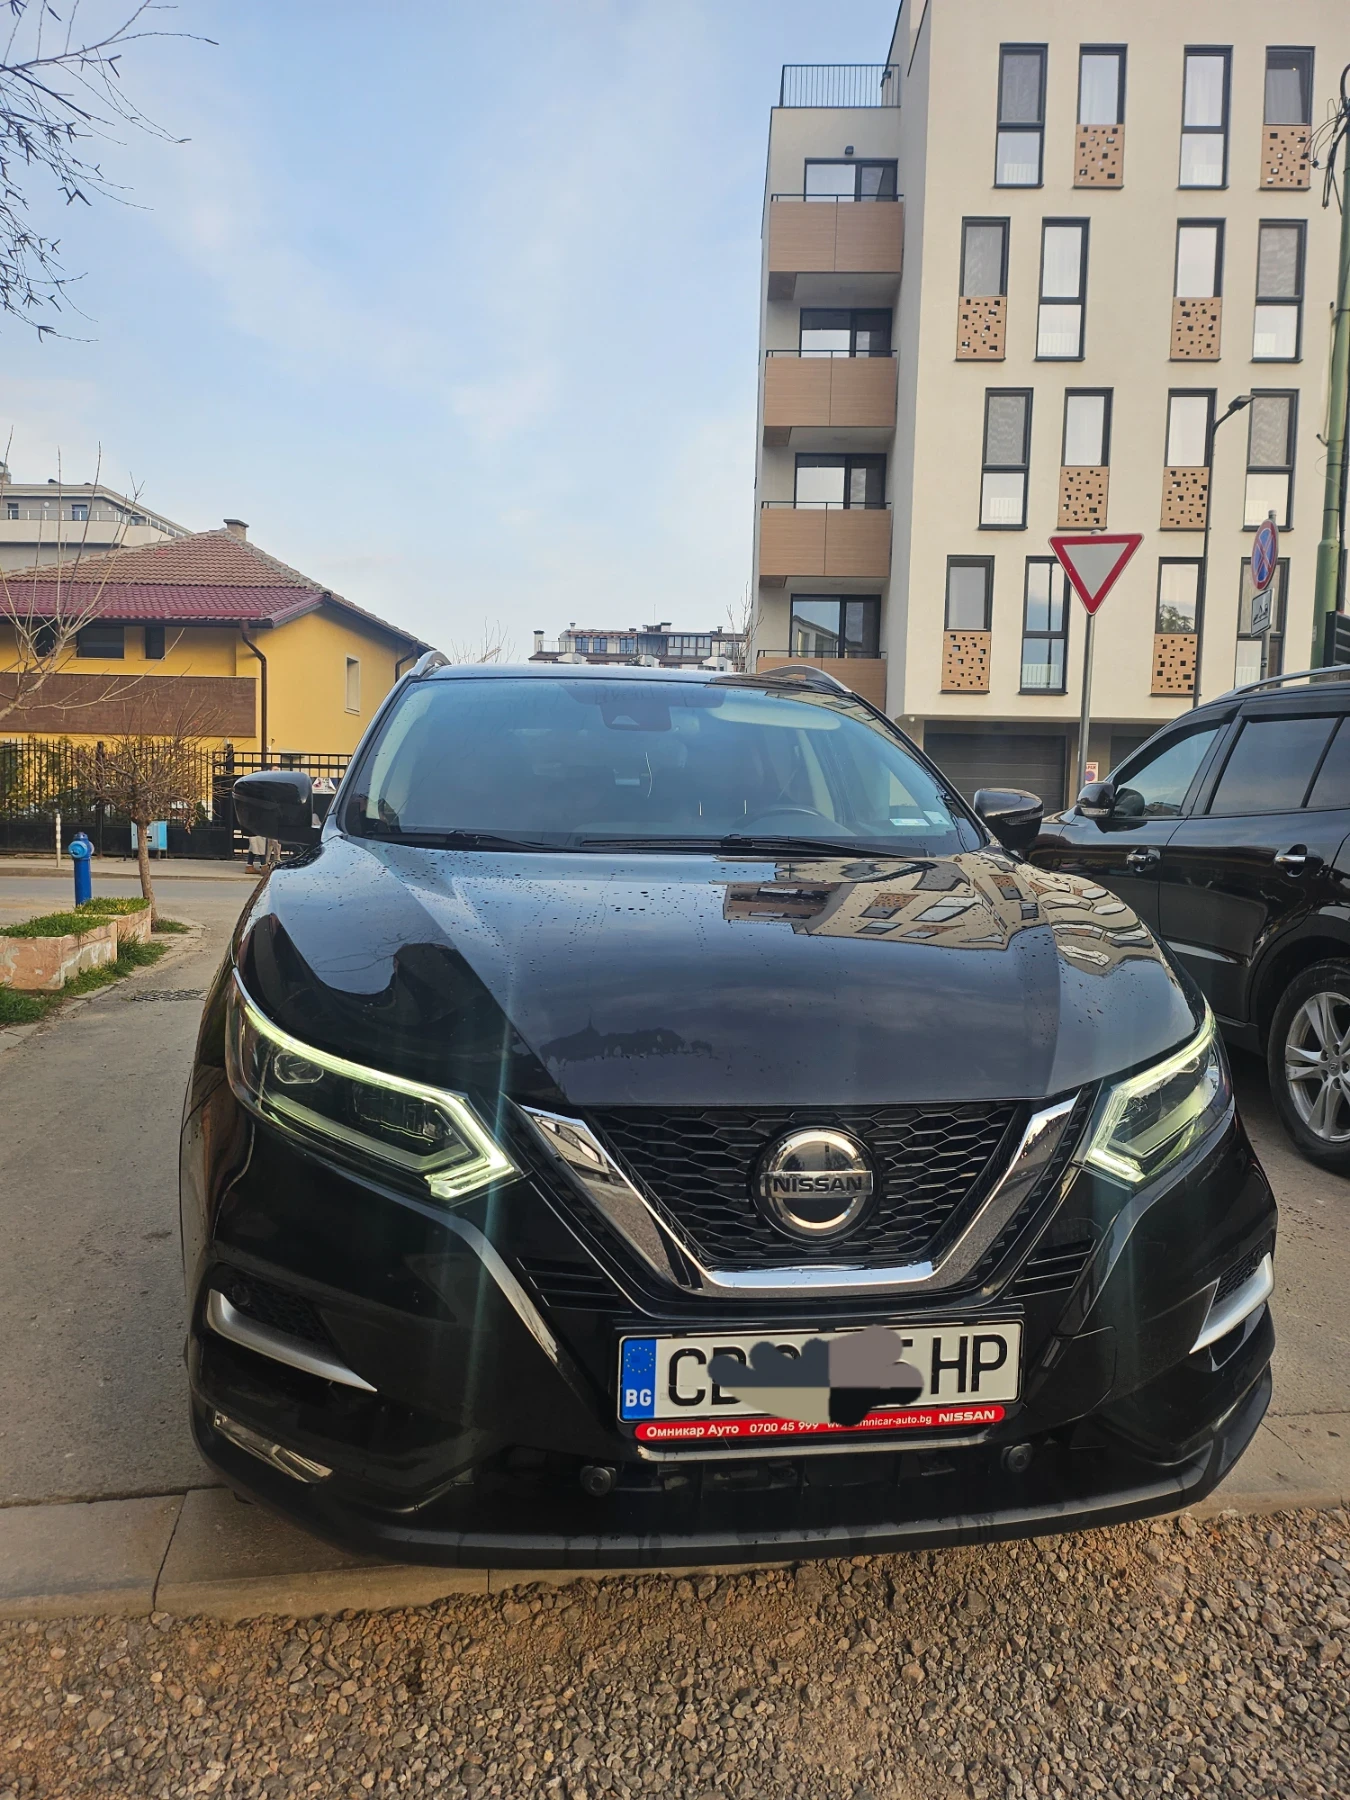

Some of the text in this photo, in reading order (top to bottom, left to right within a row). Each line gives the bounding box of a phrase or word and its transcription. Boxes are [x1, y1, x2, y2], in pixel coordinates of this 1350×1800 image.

[773, 1175, 862, 1193] NISSAN
[930, 1333, 1008, 1395] HP
[625, 1388, 652, 1408] BG
[938, 1410, 996, 1423] NISSAN
[646, 1424, 740, 1439] Омникар Ауто
[749, 1421, 819, 1434] 0700 45 999
